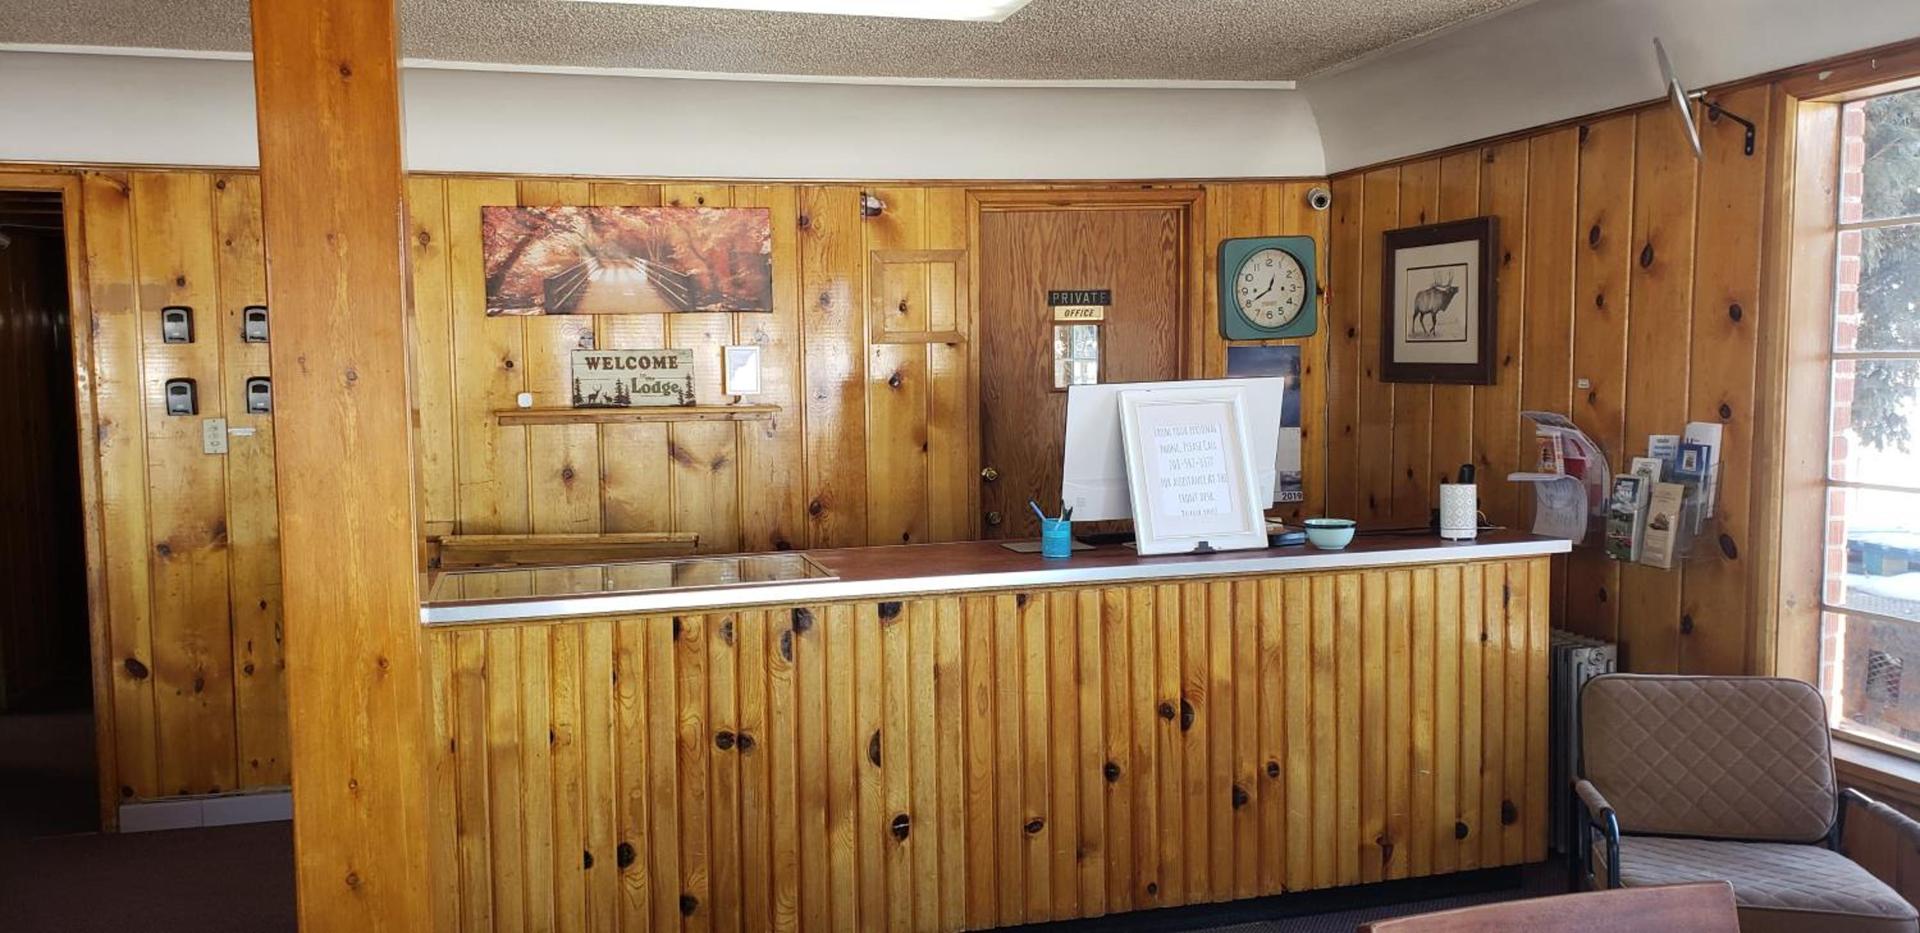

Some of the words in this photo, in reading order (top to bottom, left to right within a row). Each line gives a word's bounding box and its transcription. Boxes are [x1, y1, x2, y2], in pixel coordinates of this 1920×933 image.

[1052, 291, 1107, 305] PRIVATE
[1063, 308, 1095, 318] OFFICE
[584, 355, 679, 371] WELCOME
[631, 377, 679, 396] Lodge
[1281, 491, 1303, 501] 2019
